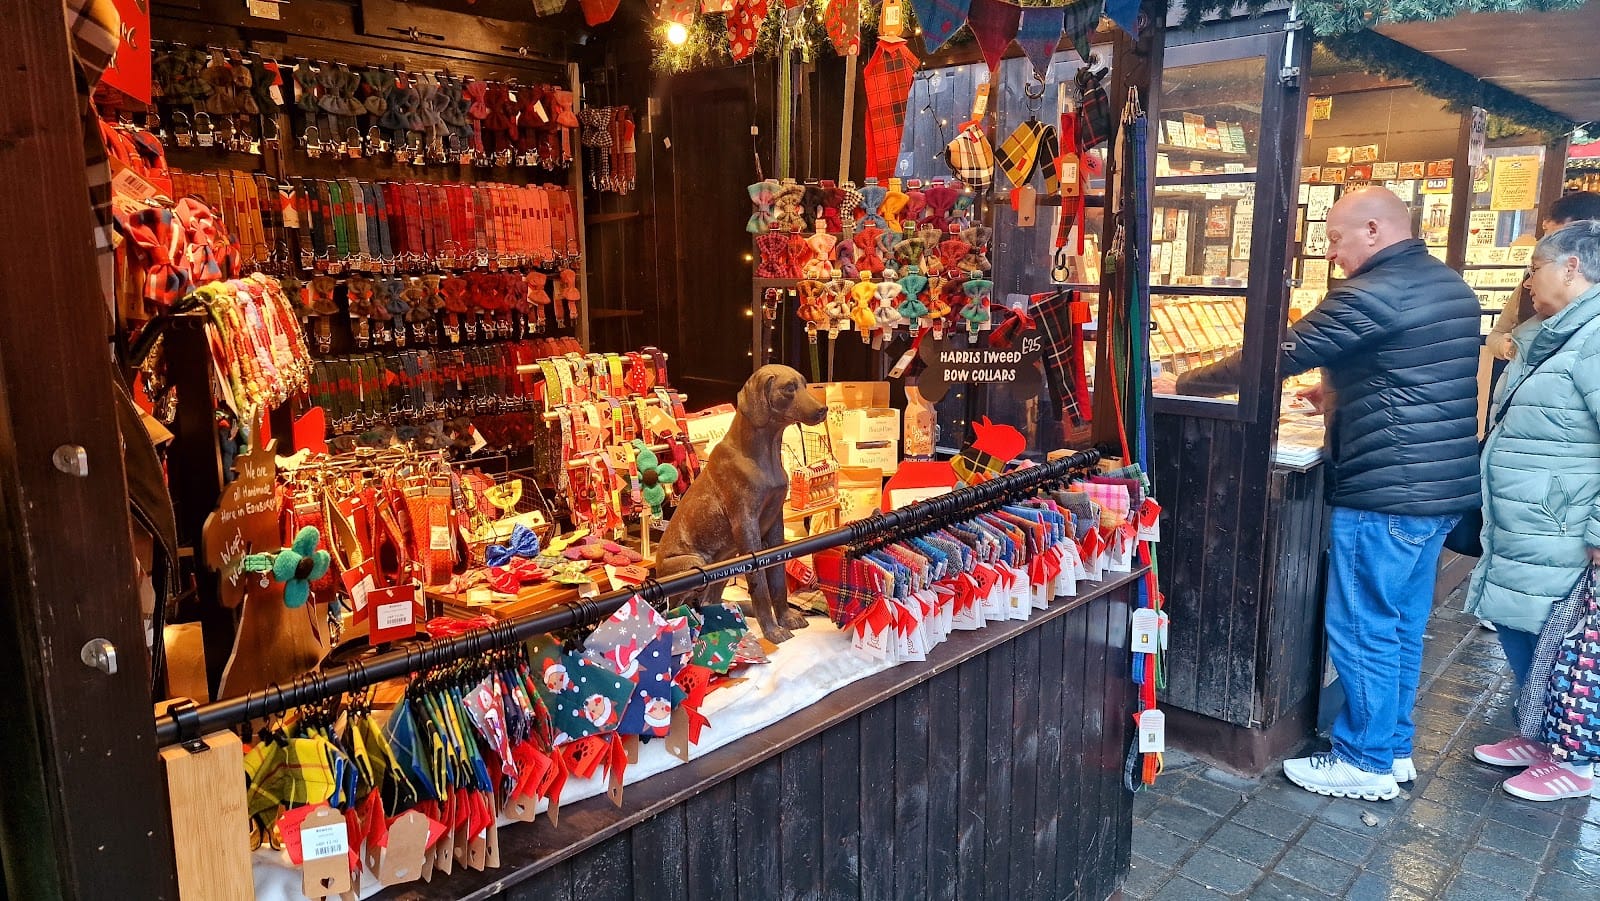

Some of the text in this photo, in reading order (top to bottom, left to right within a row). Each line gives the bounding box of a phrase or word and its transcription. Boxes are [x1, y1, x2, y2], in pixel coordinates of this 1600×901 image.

[1022, 335, 1042, 355] £25
[940, 351, 981, 364] HARRIS
[943, 369, 1016, 382] BOW COLLARS
[244, 461, 268, 479] We are
[237, 504, 245, 517] in
